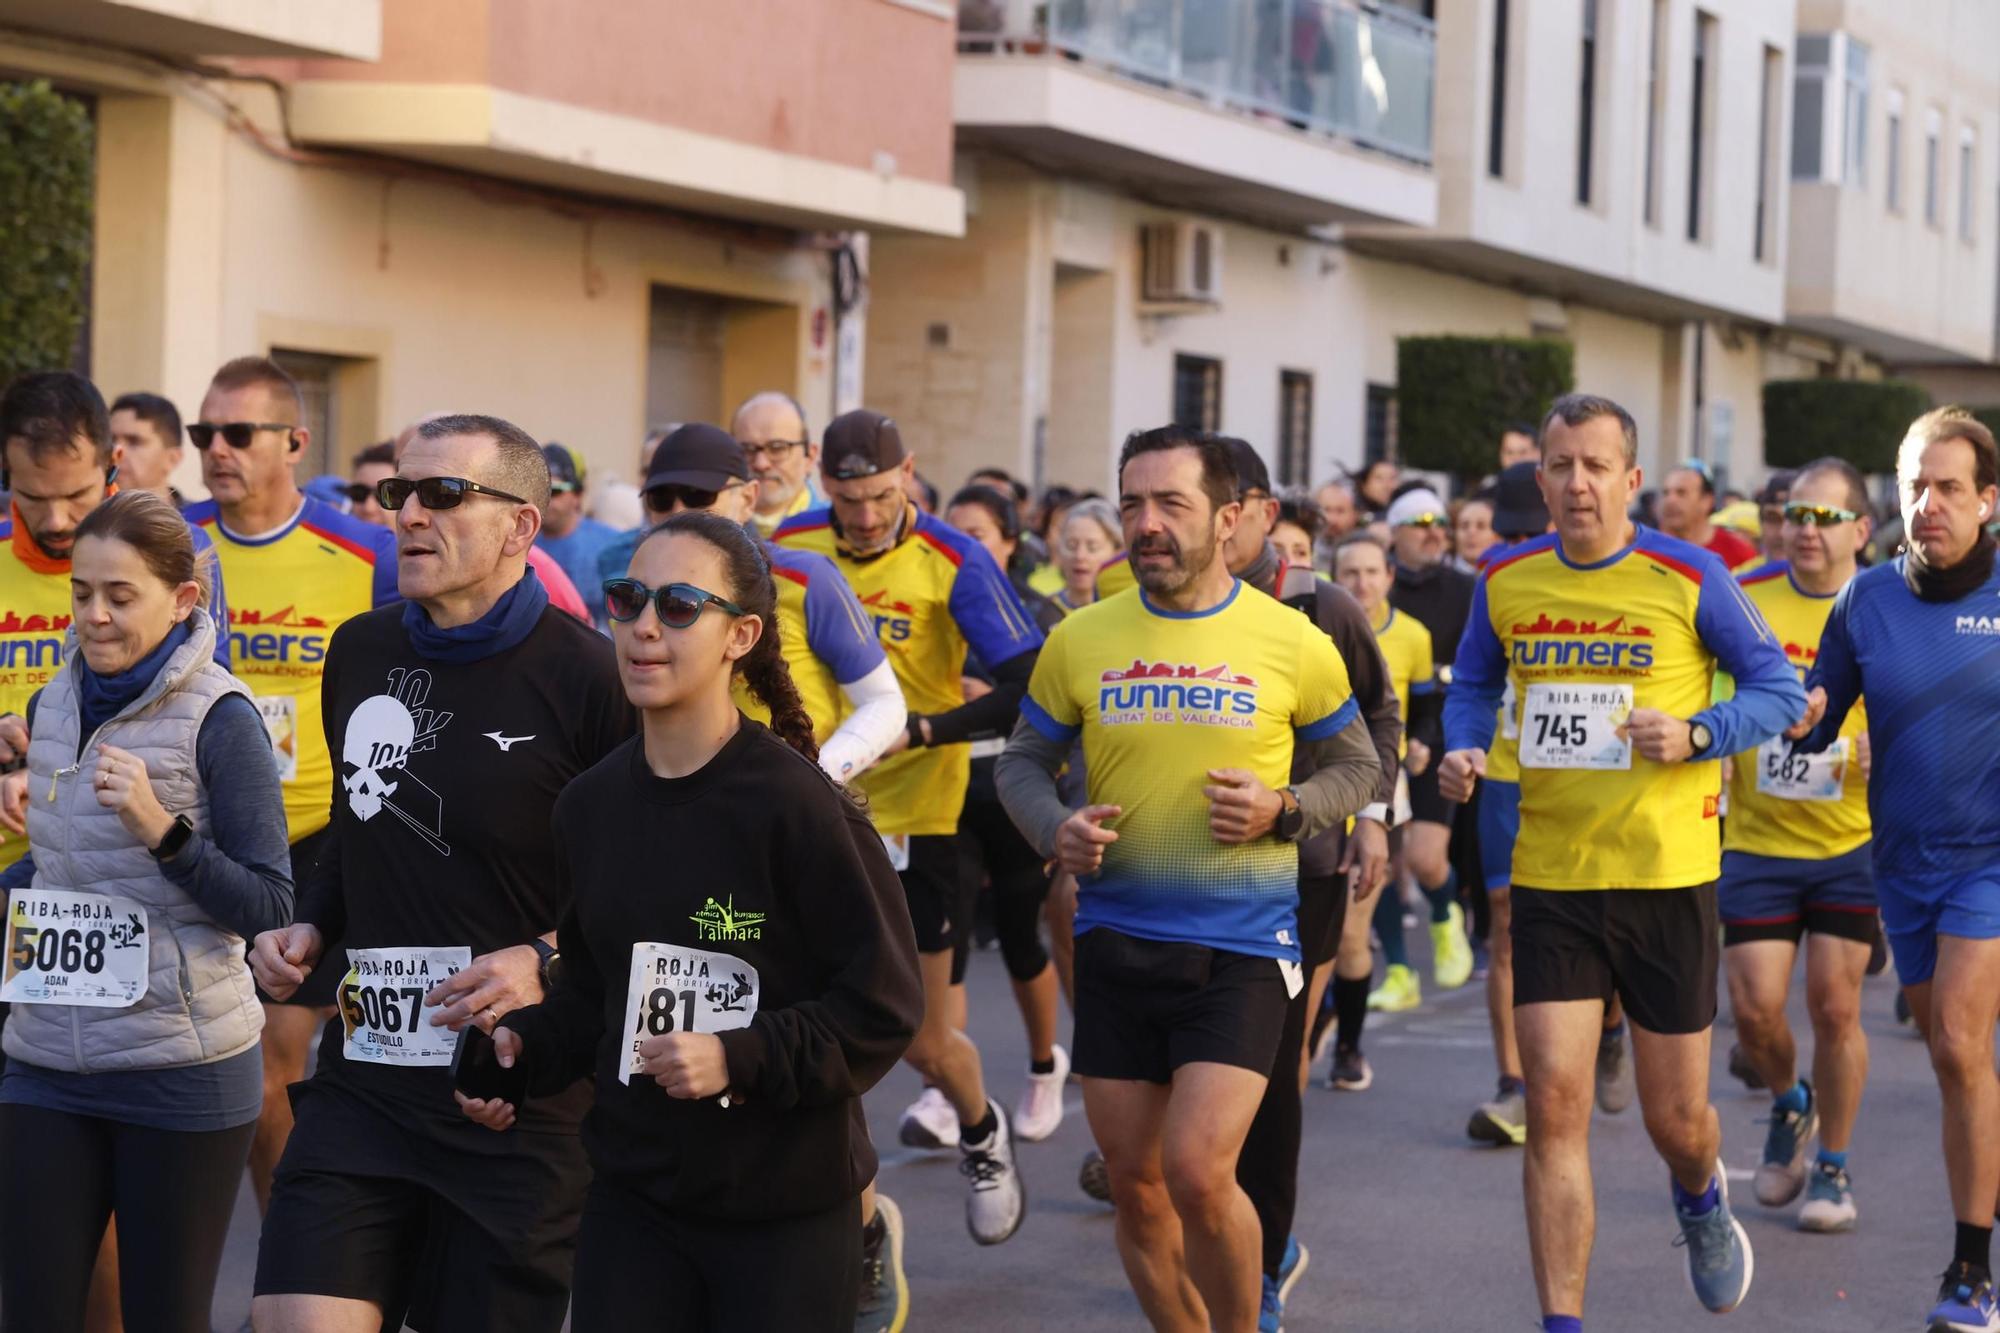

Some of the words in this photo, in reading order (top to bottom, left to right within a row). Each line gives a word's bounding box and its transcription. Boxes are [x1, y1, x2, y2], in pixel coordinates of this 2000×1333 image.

[1512, 640, 1653, 667] runners
[1100, 684, 1256, 713] runners
[1101, 713, 1145, 724] CIUTAT
[1153, 712, 1174, 722] DE
[1534, 714, 1587, 746] 745
[17, 900, 113, 920] RIBA-ROJA
[13, 927, 106, 975] 5068
[43, 975, 69, 987] ADAN
[655, 977, 669, 986] DE
[343, 984, 424, 1033] 5067
[636, 987, 697, 1036] 81
[367, 1031, 403, 1048] ESTUDILLO
